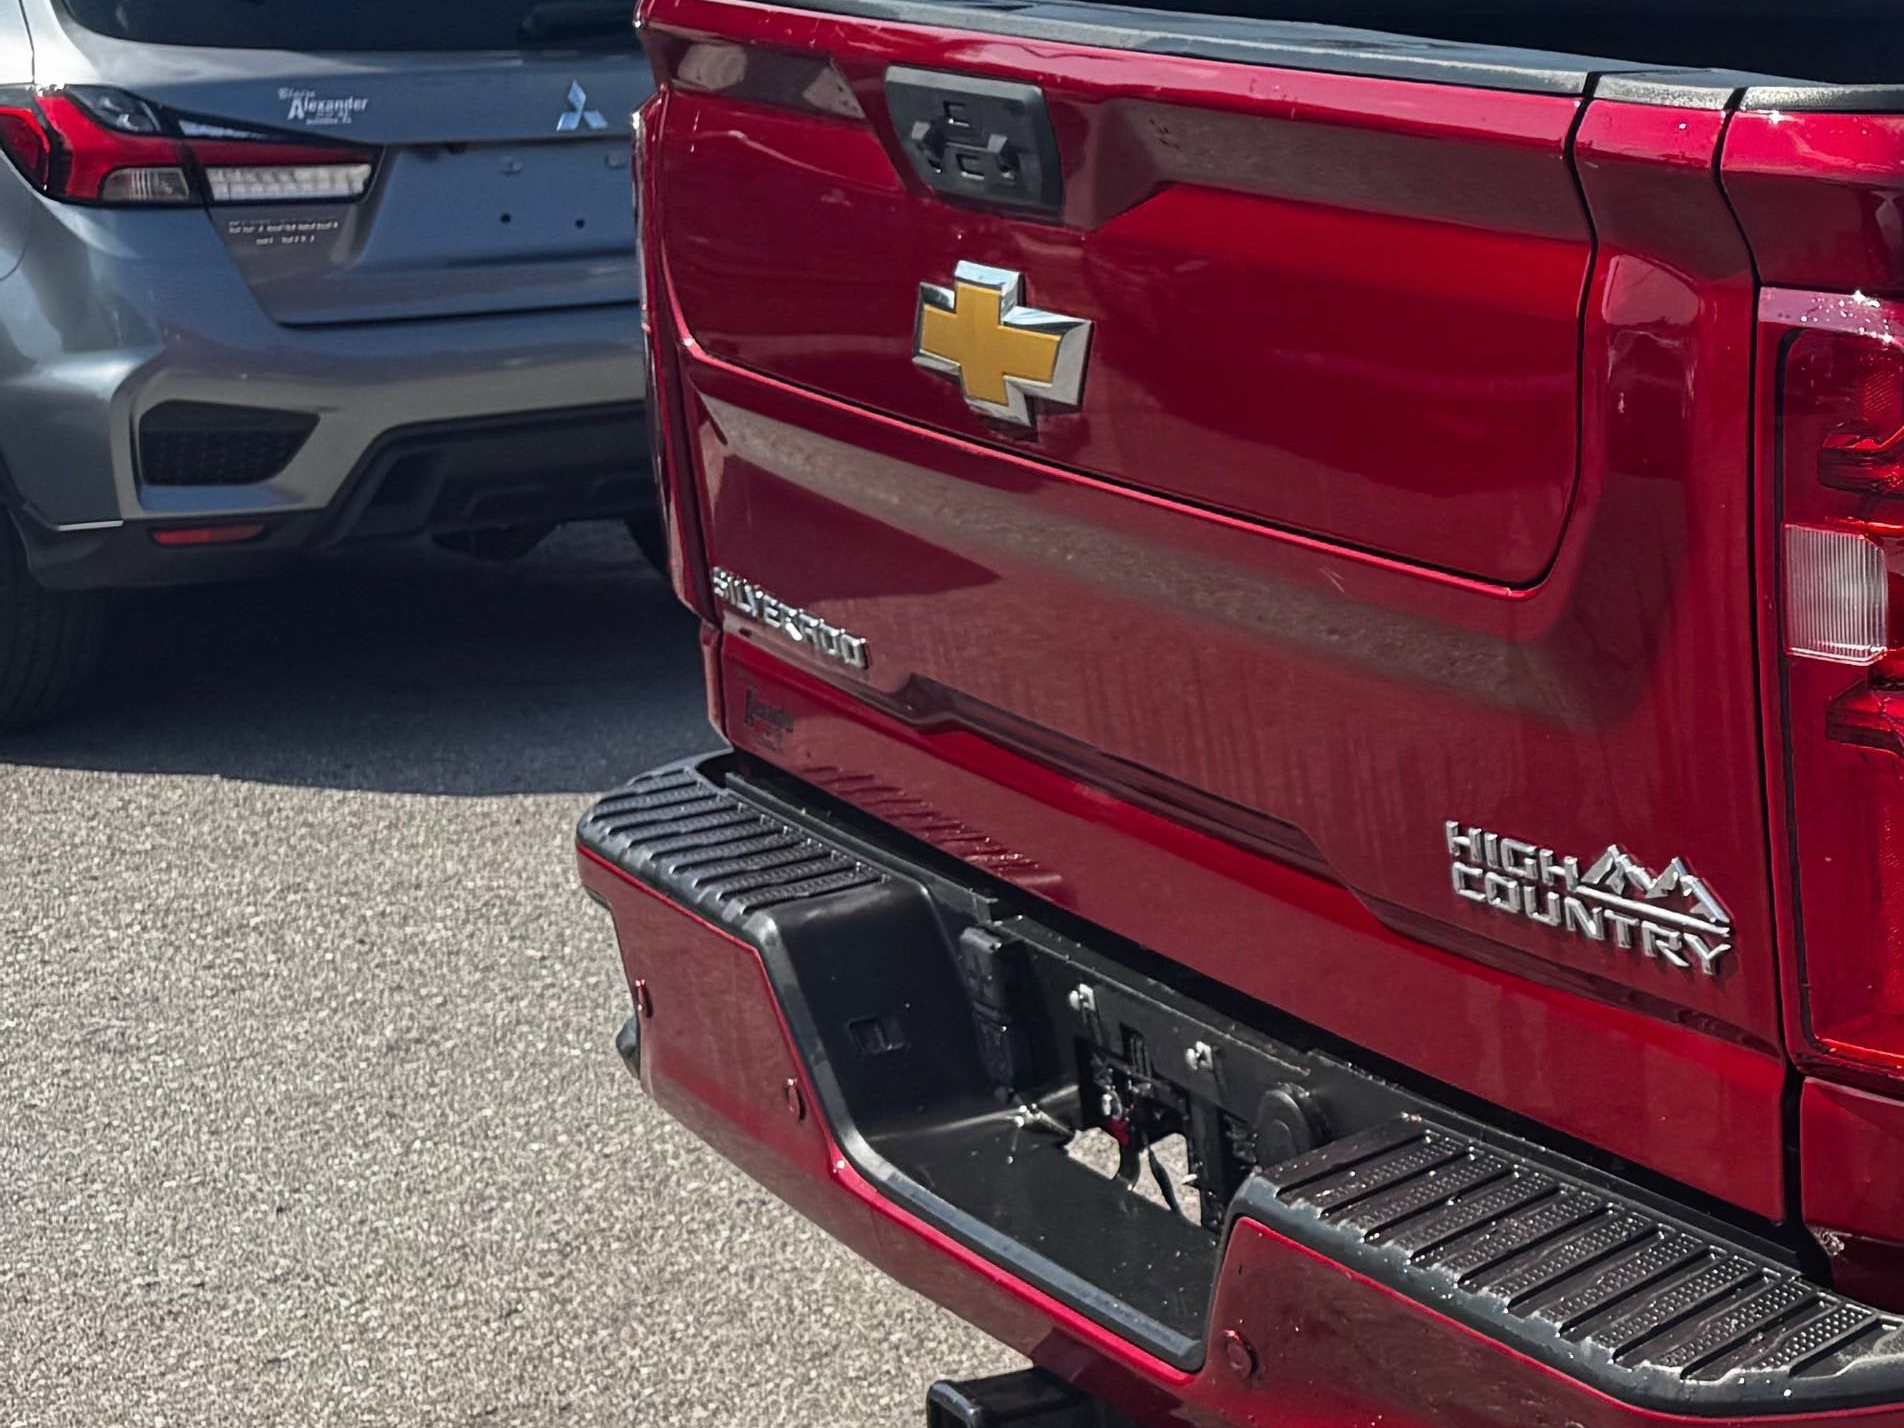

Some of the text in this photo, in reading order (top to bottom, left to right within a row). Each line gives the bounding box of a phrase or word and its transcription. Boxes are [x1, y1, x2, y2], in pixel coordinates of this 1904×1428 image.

[287, 95, 369, 120] Alexander
[713, 567, 869, 670] SILVERADO
[1446, 820, 1579, 893] HIGH
[1452, 861, 1732, 975] COUNTRY
